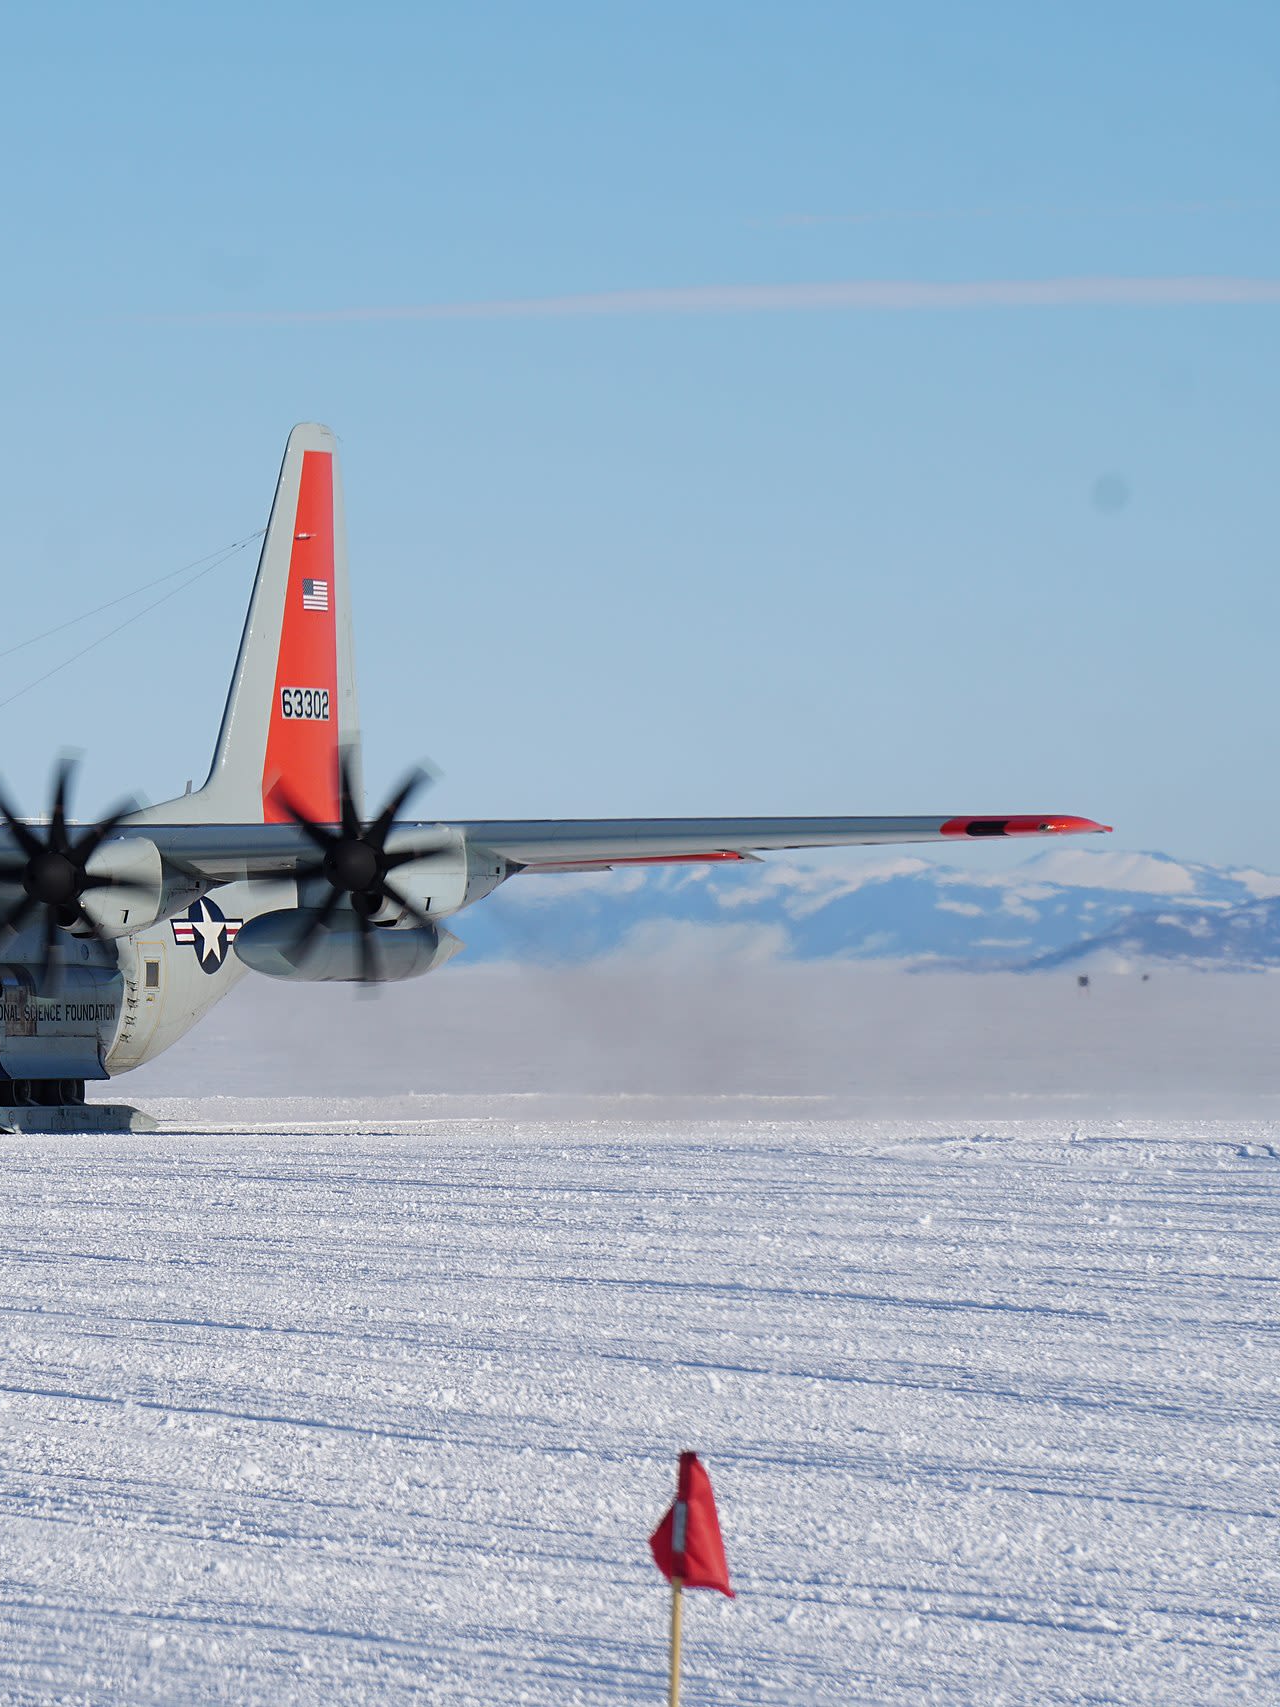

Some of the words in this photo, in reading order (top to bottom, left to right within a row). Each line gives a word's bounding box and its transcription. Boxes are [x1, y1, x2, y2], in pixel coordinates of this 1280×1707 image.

[282, 689, 329, 719] 63302
[24, 1004, 62, 1021] SCIENCE
[65, 1004, 116, 1021] FOUNDATION
